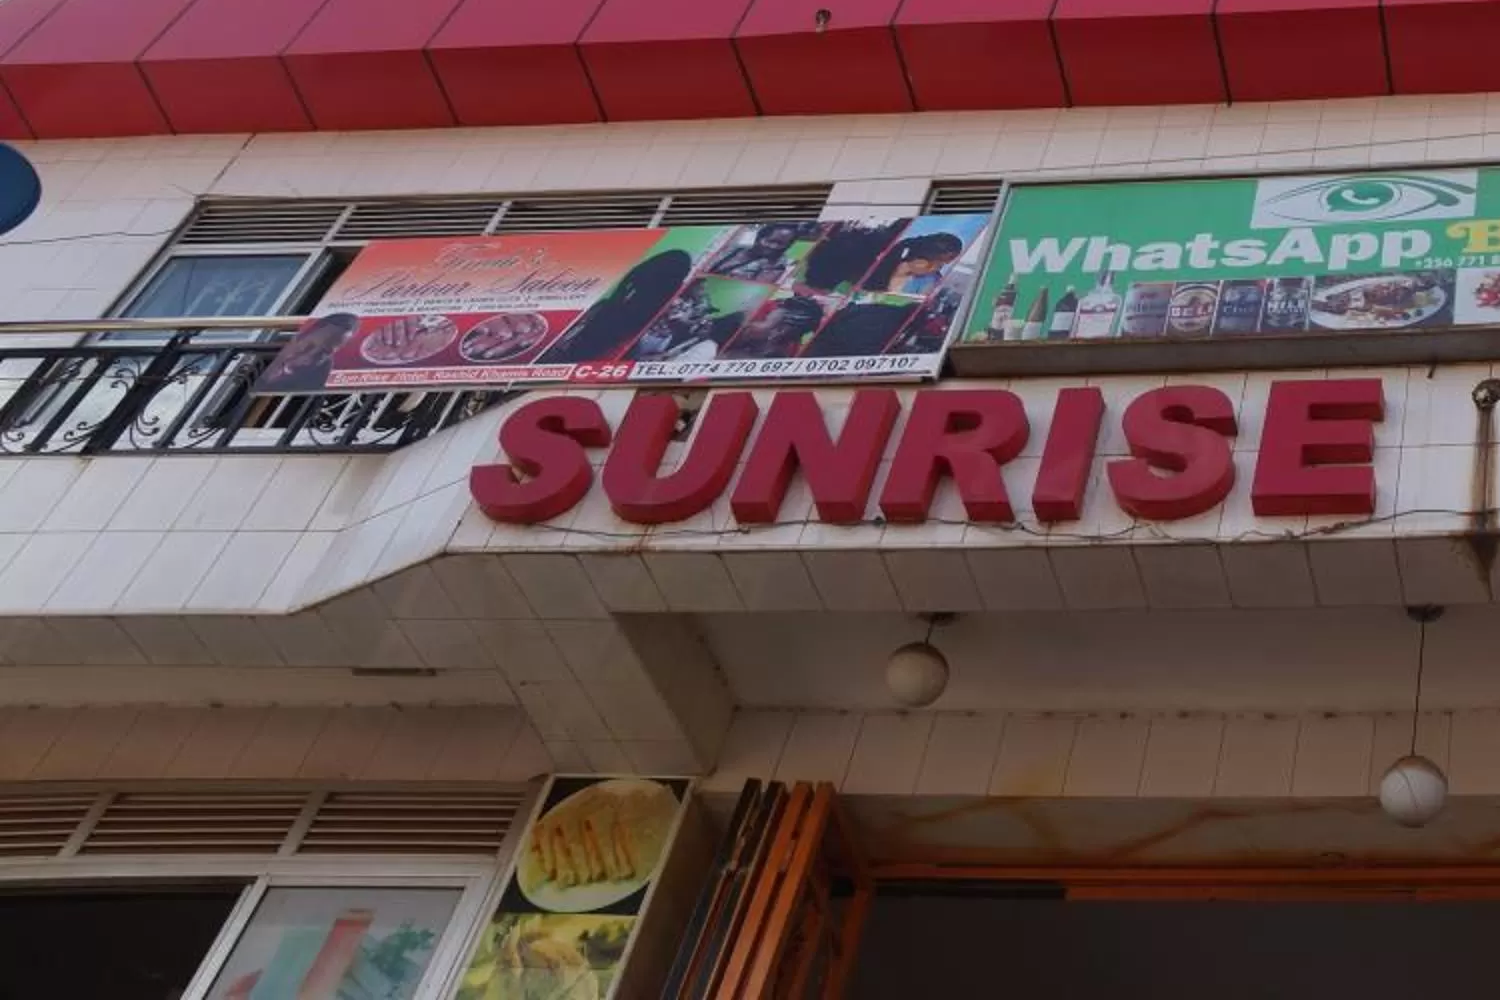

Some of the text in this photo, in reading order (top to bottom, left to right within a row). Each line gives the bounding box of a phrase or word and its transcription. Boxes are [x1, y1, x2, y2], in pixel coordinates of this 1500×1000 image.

[1009, 227, 1432, 273] WhatsApp
[575, 363, 629, 379] C-26
[636, 362, 674, 376] TEL:
[677, 360, 721, 375] 0774
[724, 359, 758, 373] 770
[805, 358, 851, 372] 0702
[470, 377, 1386, 525] SUNRISE
